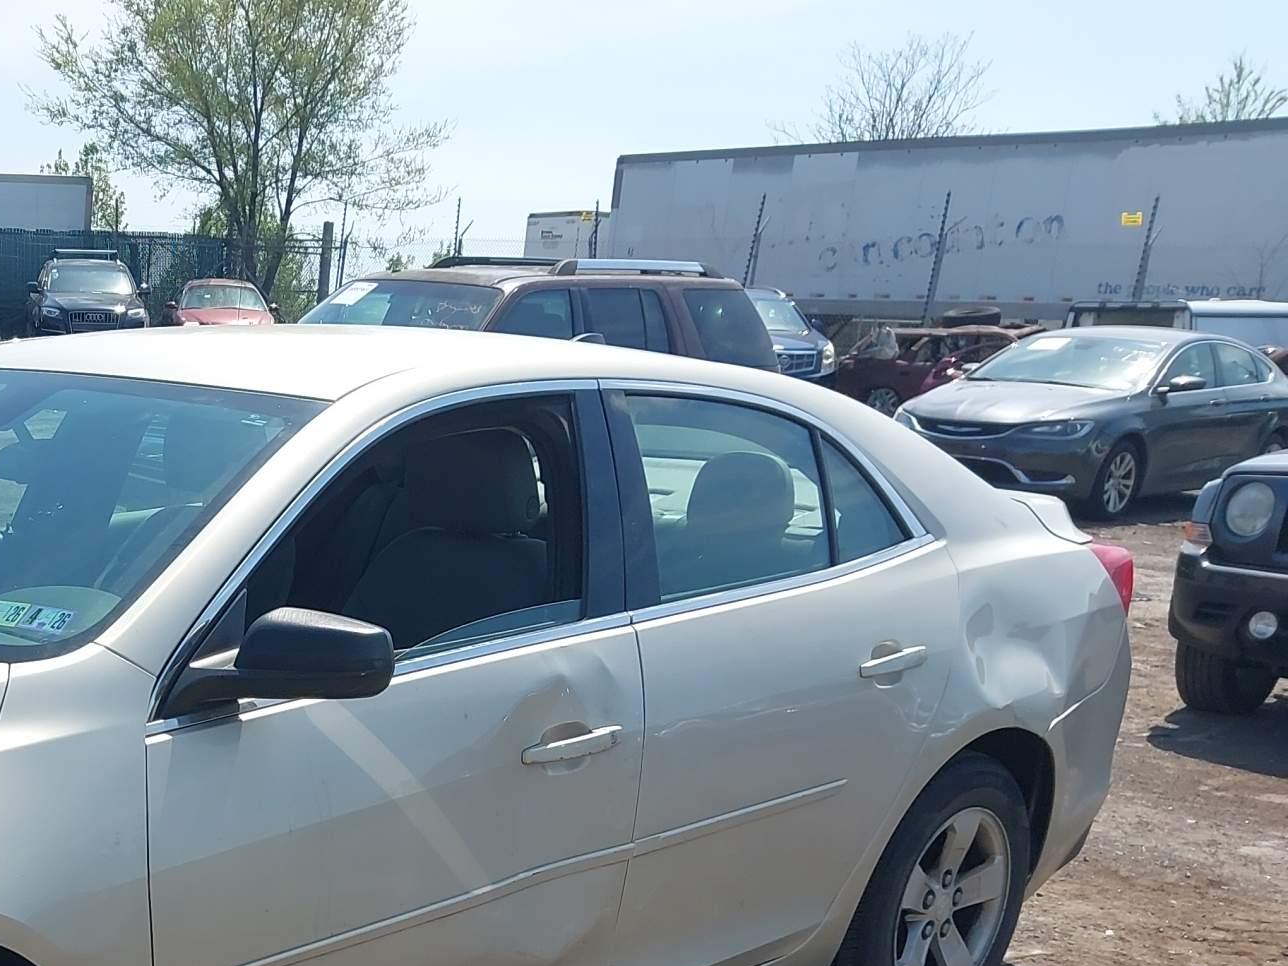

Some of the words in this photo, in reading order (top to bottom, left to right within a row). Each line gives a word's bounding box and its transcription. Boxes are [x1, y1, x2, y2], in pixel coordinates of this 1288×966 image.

[1097, 281, 1122, 296] the
[1127, 284, 1181, 299] pople
[1184, 283, 1220, 298] who
[1226, 284, 1266, 298] care
